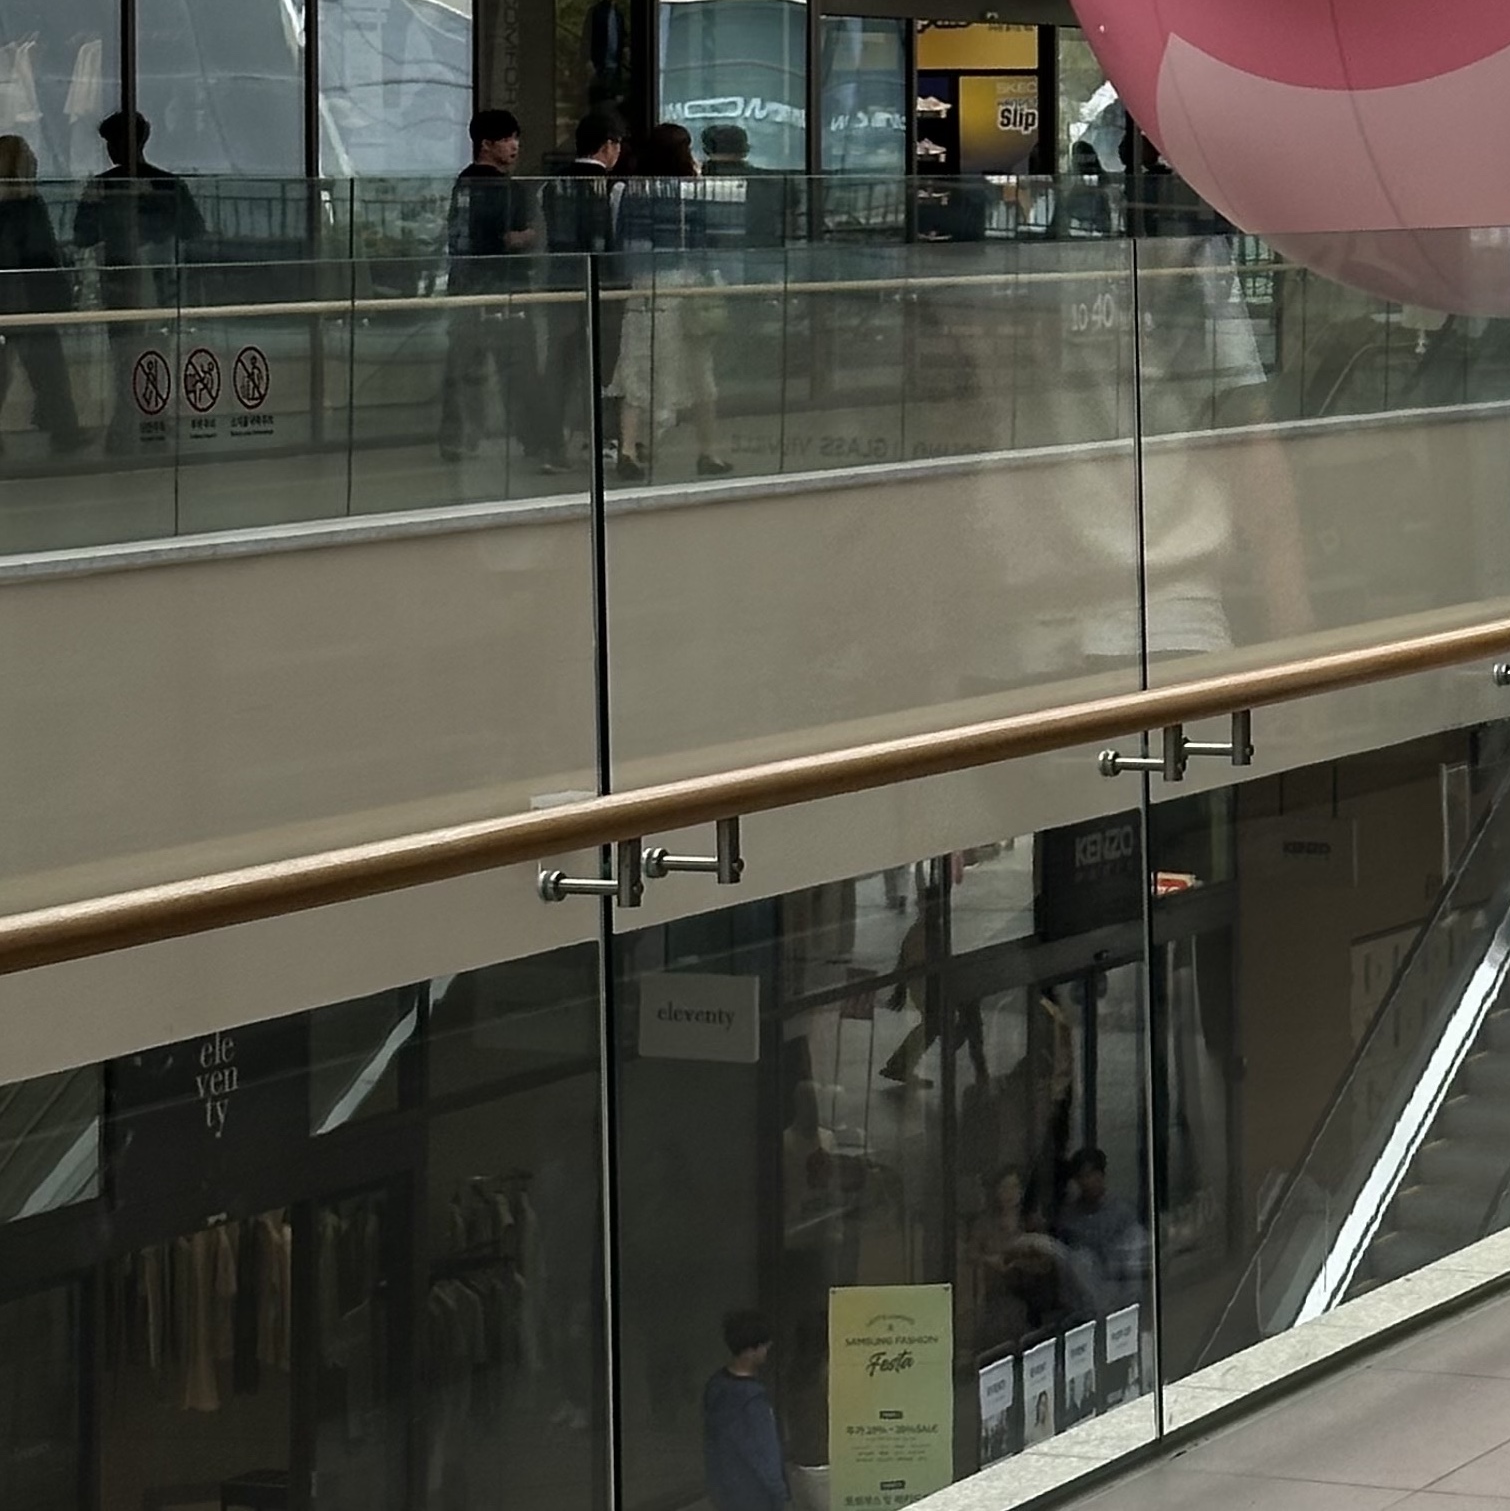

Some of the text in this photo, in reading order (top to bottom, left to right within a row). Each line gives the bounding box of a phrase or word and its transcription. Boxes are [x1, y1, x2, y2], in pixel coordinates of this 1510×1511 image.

[1000, 104, 1038, 132] Slip
[1075, 825, 1134, 867] KENZO
[657, 1000, 735, 1031] eleventy
[201, 1031, 235, 1068] ele
[196, 1067, 239, 1098] ven
[206, 1096, 229, 1138] ty
[866, 1349, 915, 1377] Festa
